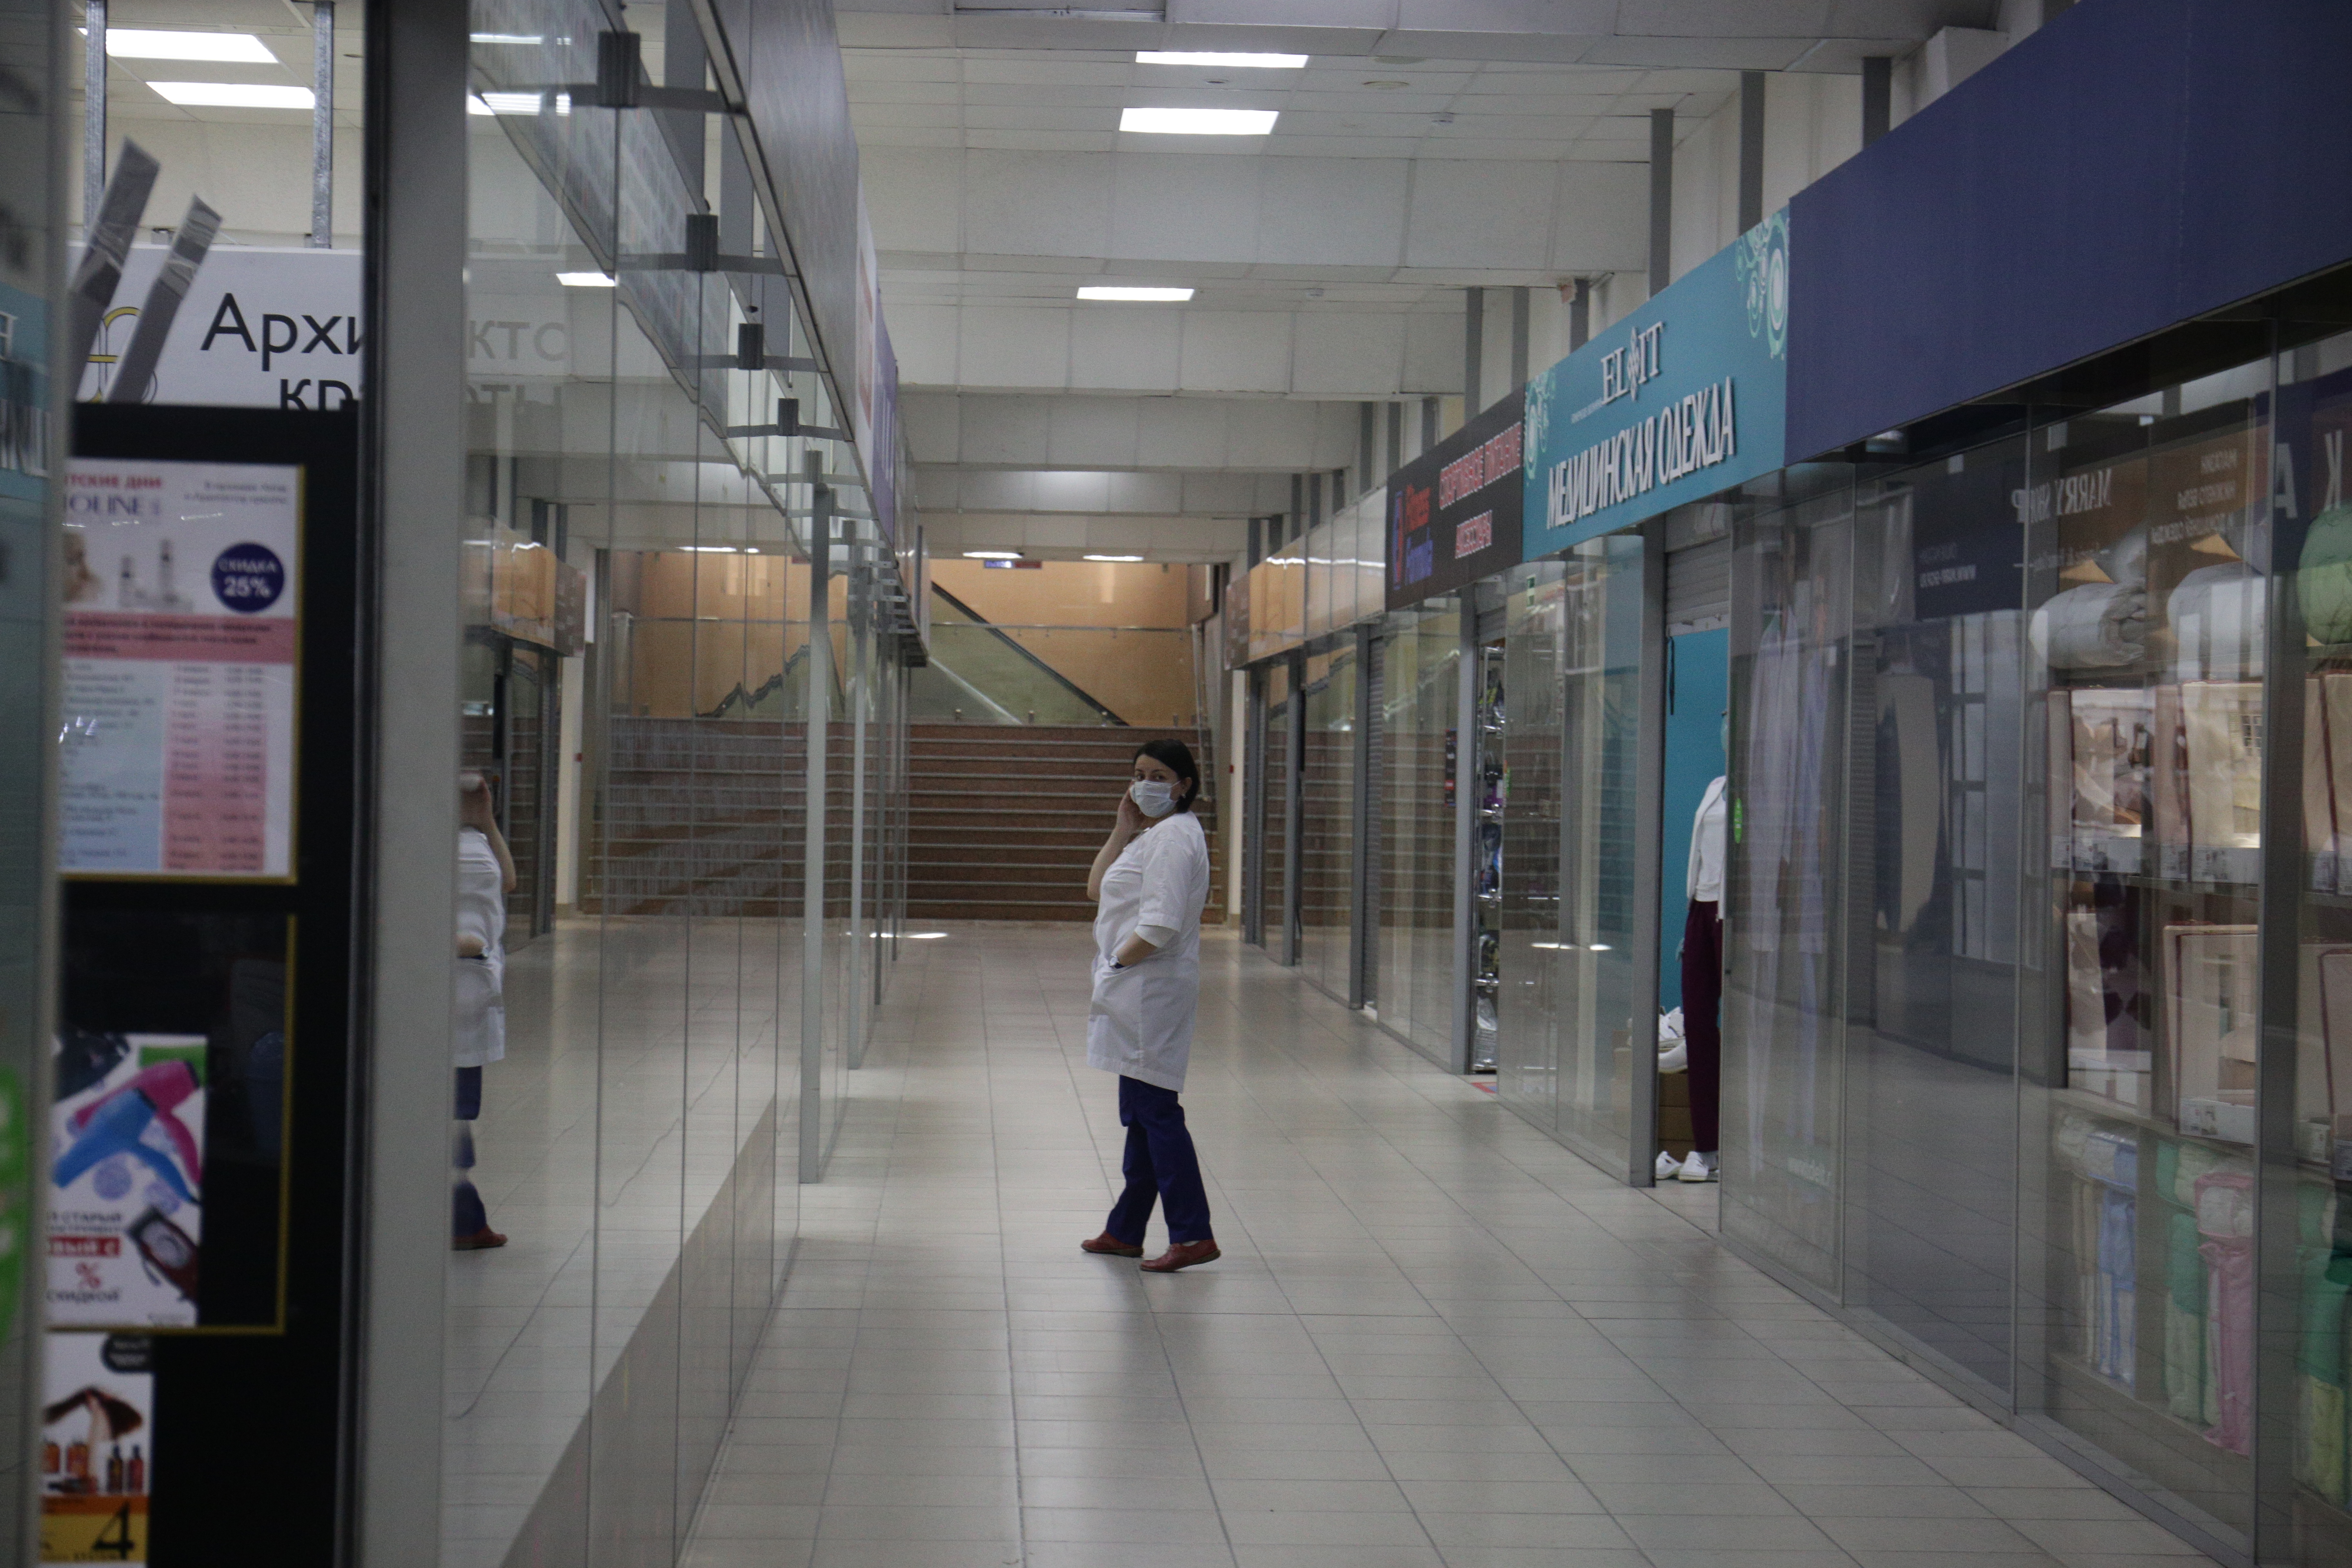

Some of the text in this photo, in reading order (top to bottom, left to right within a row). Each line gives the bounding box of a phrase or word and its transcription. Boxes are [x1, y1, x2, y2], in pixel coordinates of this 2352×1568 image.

[1546, 415, 1657, 530] МЕДИЦИНСКАЯ
[1658, 376, 1736, 485] ОДЕЖДА
[223, 575, 272, 598] 25%
